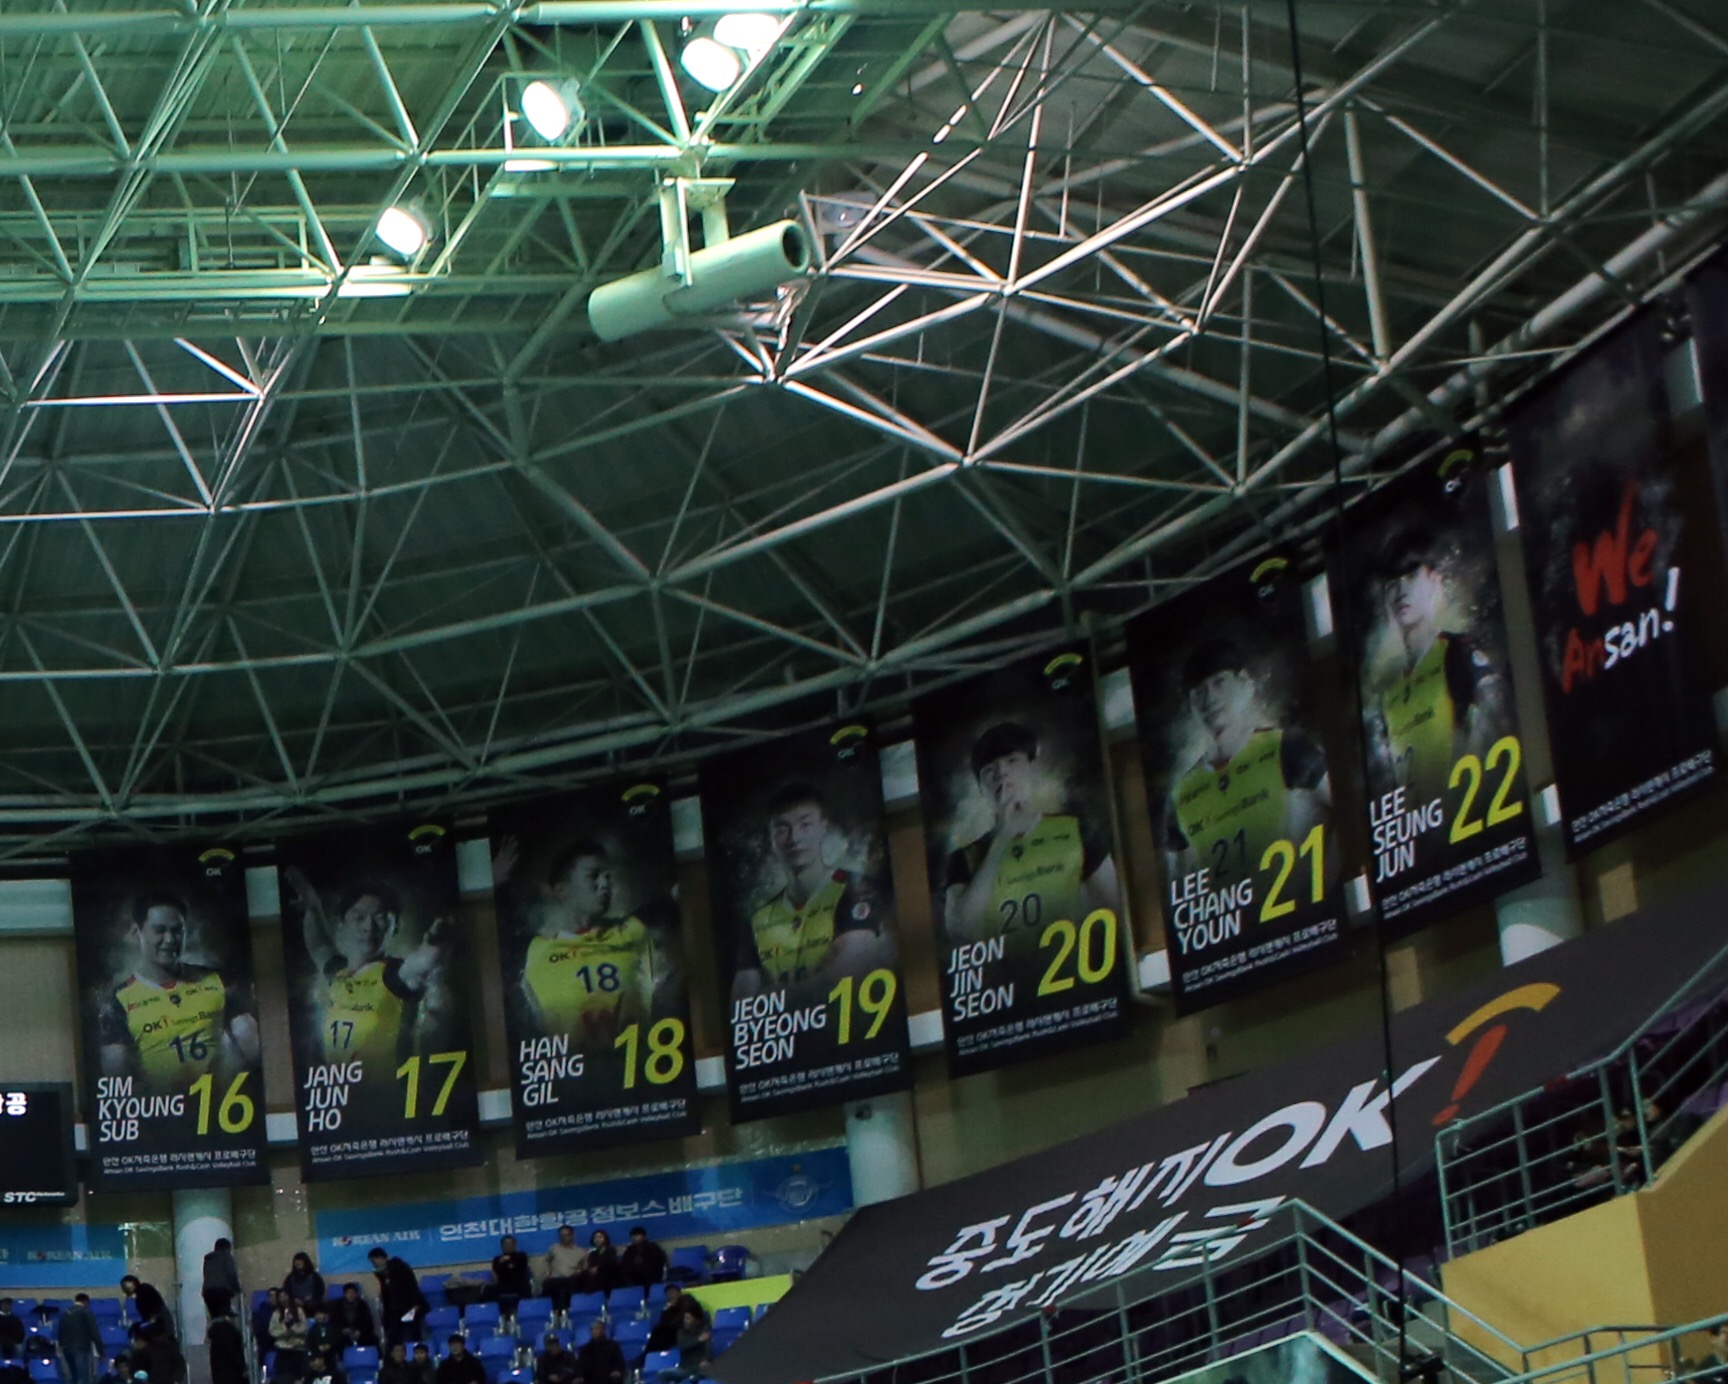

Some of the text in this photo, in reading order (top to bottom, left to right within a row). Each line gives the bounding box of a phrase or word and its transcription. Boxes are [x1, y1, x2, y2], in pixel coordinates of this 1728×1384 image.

[1571, 475, 1659, 616] We
[1561, 565, 1683, 697] Ansan!
[1369, 786, 1407, 827] LEE
[1448, 736, 1524, 845] 22
[1372, 798, 1443, 856] SEUNG
[1258, 823, 1326, 925] 21
[1375, 843, 1416, 884] JUN
[1170, 868, 1210, 906] LEE
[1172, 878, 1253, 931] CHANG
[1036, 907, 1118, 998] 20
[1176, 914, 1242, 957] YOUN
[947, 937, 1005, 974] JEON
[950, 966, 985, 999] JIN
[730, 990, 786, 1024] JEON
[827, 968, 898, 1046] 19
[952, 983, 1015, 1022] SEON
[733, 1003, 827, 1048] BYEONG
[519, 1033, 569, 1063] HAN
[613, 1017, 685, 1089] 18
[734, 1035, 795, 1071] SEON
[96, 1076, 133, 1098] SIM
[303, 1061, 363, 1089] JANG
[395, 1050, 469, 1120] 17
[520, 1055, 585, 1085] SANG
[98, 1095, 186, 1121] KYOUNG
[188, 1071, 255, 1135] 16
[304, 1085, 349, 1111] JUN
[522, 1082, 559, 1108] GIL
[99, 1120, 139, 1143] SUB
[308, 1109, 342, 1133] HO
[4, 1191, 37, 1202] STC
